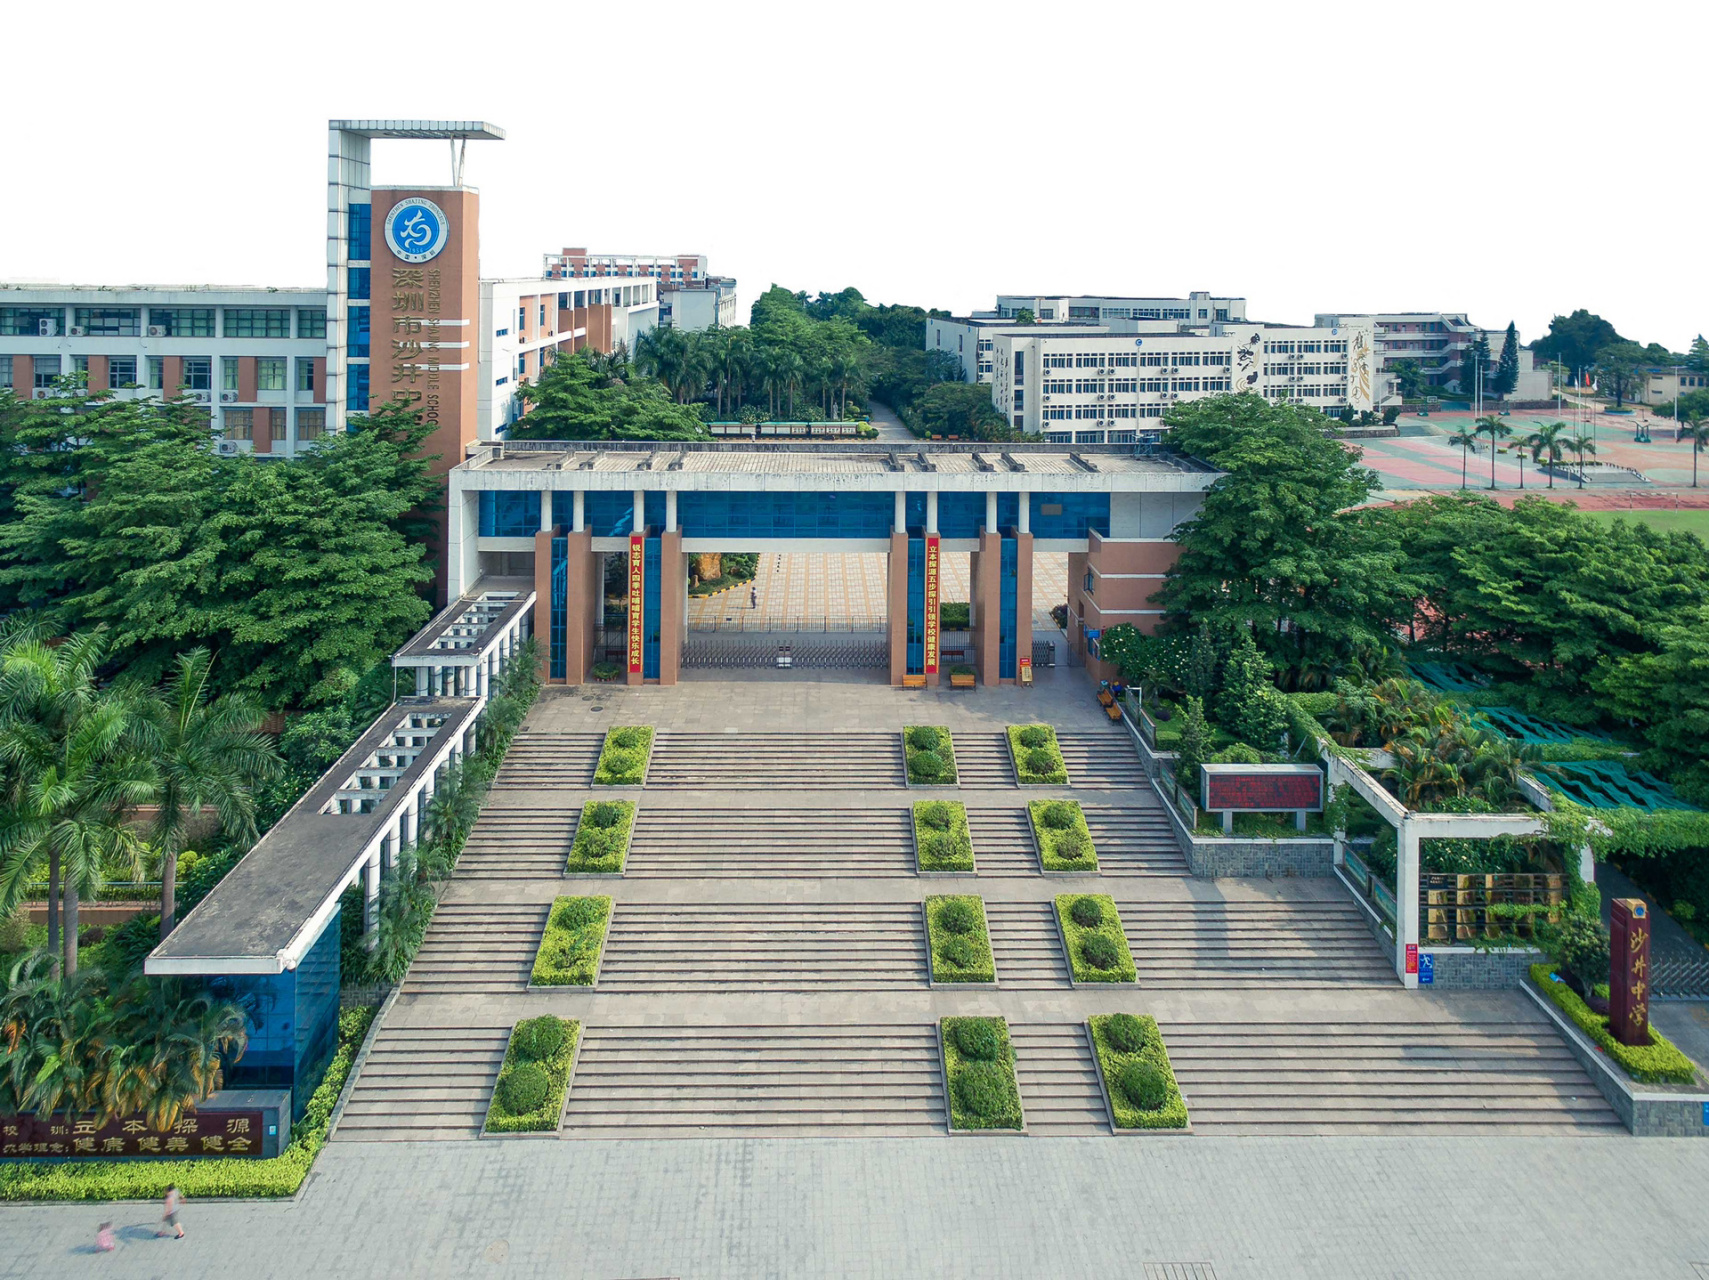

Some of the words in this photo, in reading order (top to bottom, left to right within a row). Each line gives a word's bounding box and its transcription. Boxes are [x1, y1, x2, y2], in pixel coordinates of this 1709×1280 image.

[428, 268, 440, 313] SHENZHEN
[391, 267, 424, 425] 深圳市沙井中
[428, 317, 440, 353] SHAJING
[427, 356, 440, 390] MIDDLE
[1629, 926, 1648, 1027] 沙井中学
